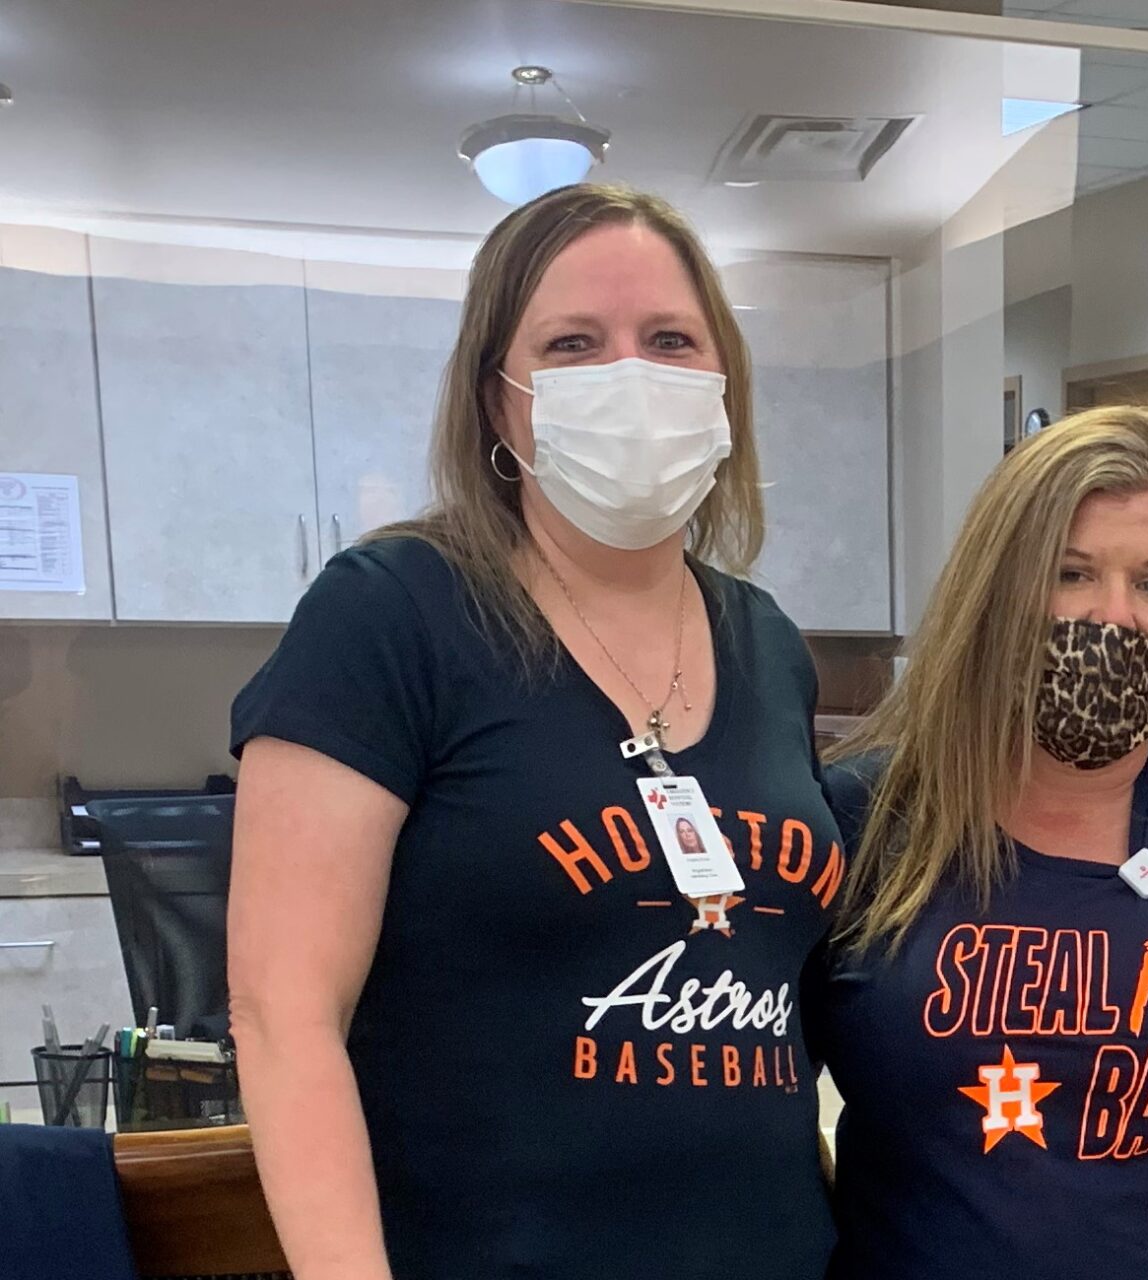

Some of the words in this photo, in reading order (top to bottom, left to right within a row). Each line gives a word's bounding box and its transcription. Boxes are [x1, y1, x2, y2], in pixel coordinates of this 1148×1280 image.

[537, 805, 846, 910] HOTON
[581, 939, 793, 1037] Astros
[923, 923, 1120, 1037] STEAL
[573, 1035, 799, 1087] BASEBALL
